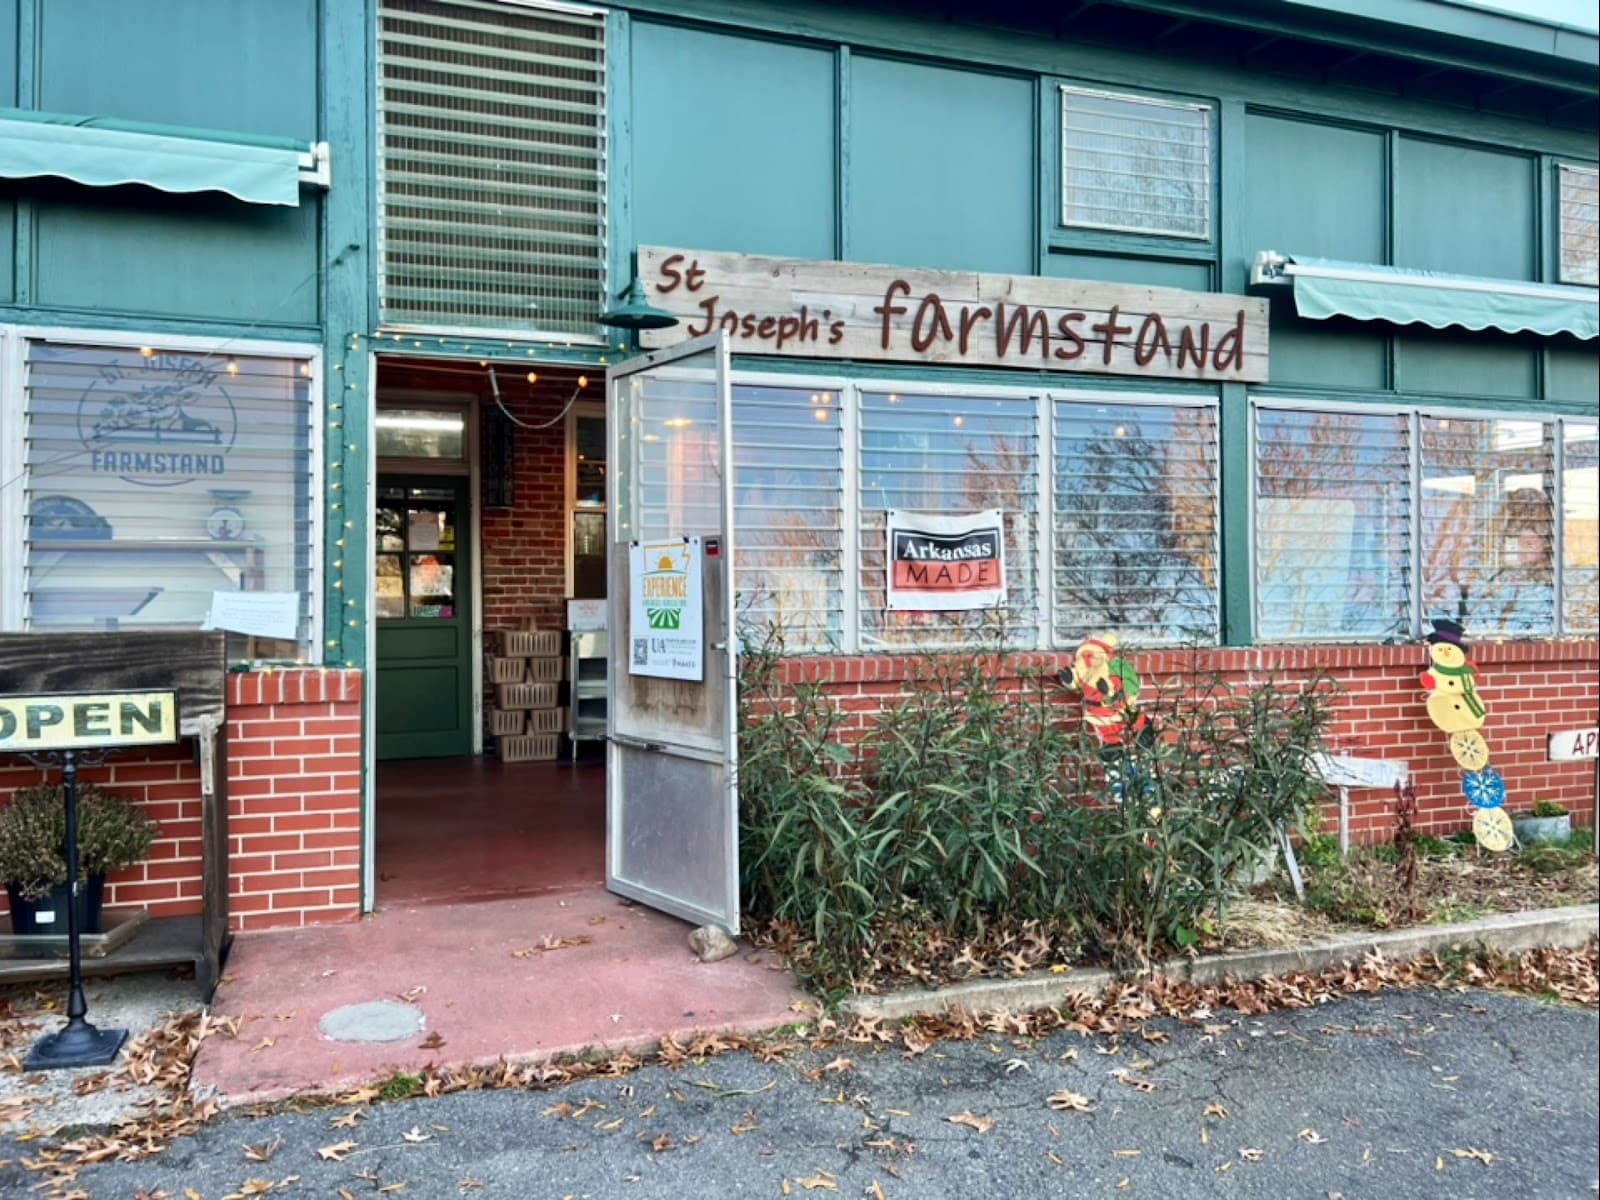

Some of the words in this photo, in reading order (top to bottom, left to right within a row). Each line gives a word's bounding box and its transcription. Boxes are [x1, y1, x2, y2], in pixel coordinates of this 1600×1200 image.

[656, 254, 706, 294] St
[687, 294, 845, 350] Joseph's
[873, 279, 1245, 372] farmstand
[92, 450, 225, 475] FARMSTAND
[903, 539, 992, 561] Arkansas
[906, 561, 990, 585] MADE
[642, 575, 688, 599] EXPERIENCE
[1572, 731, 1598, 756] AP
